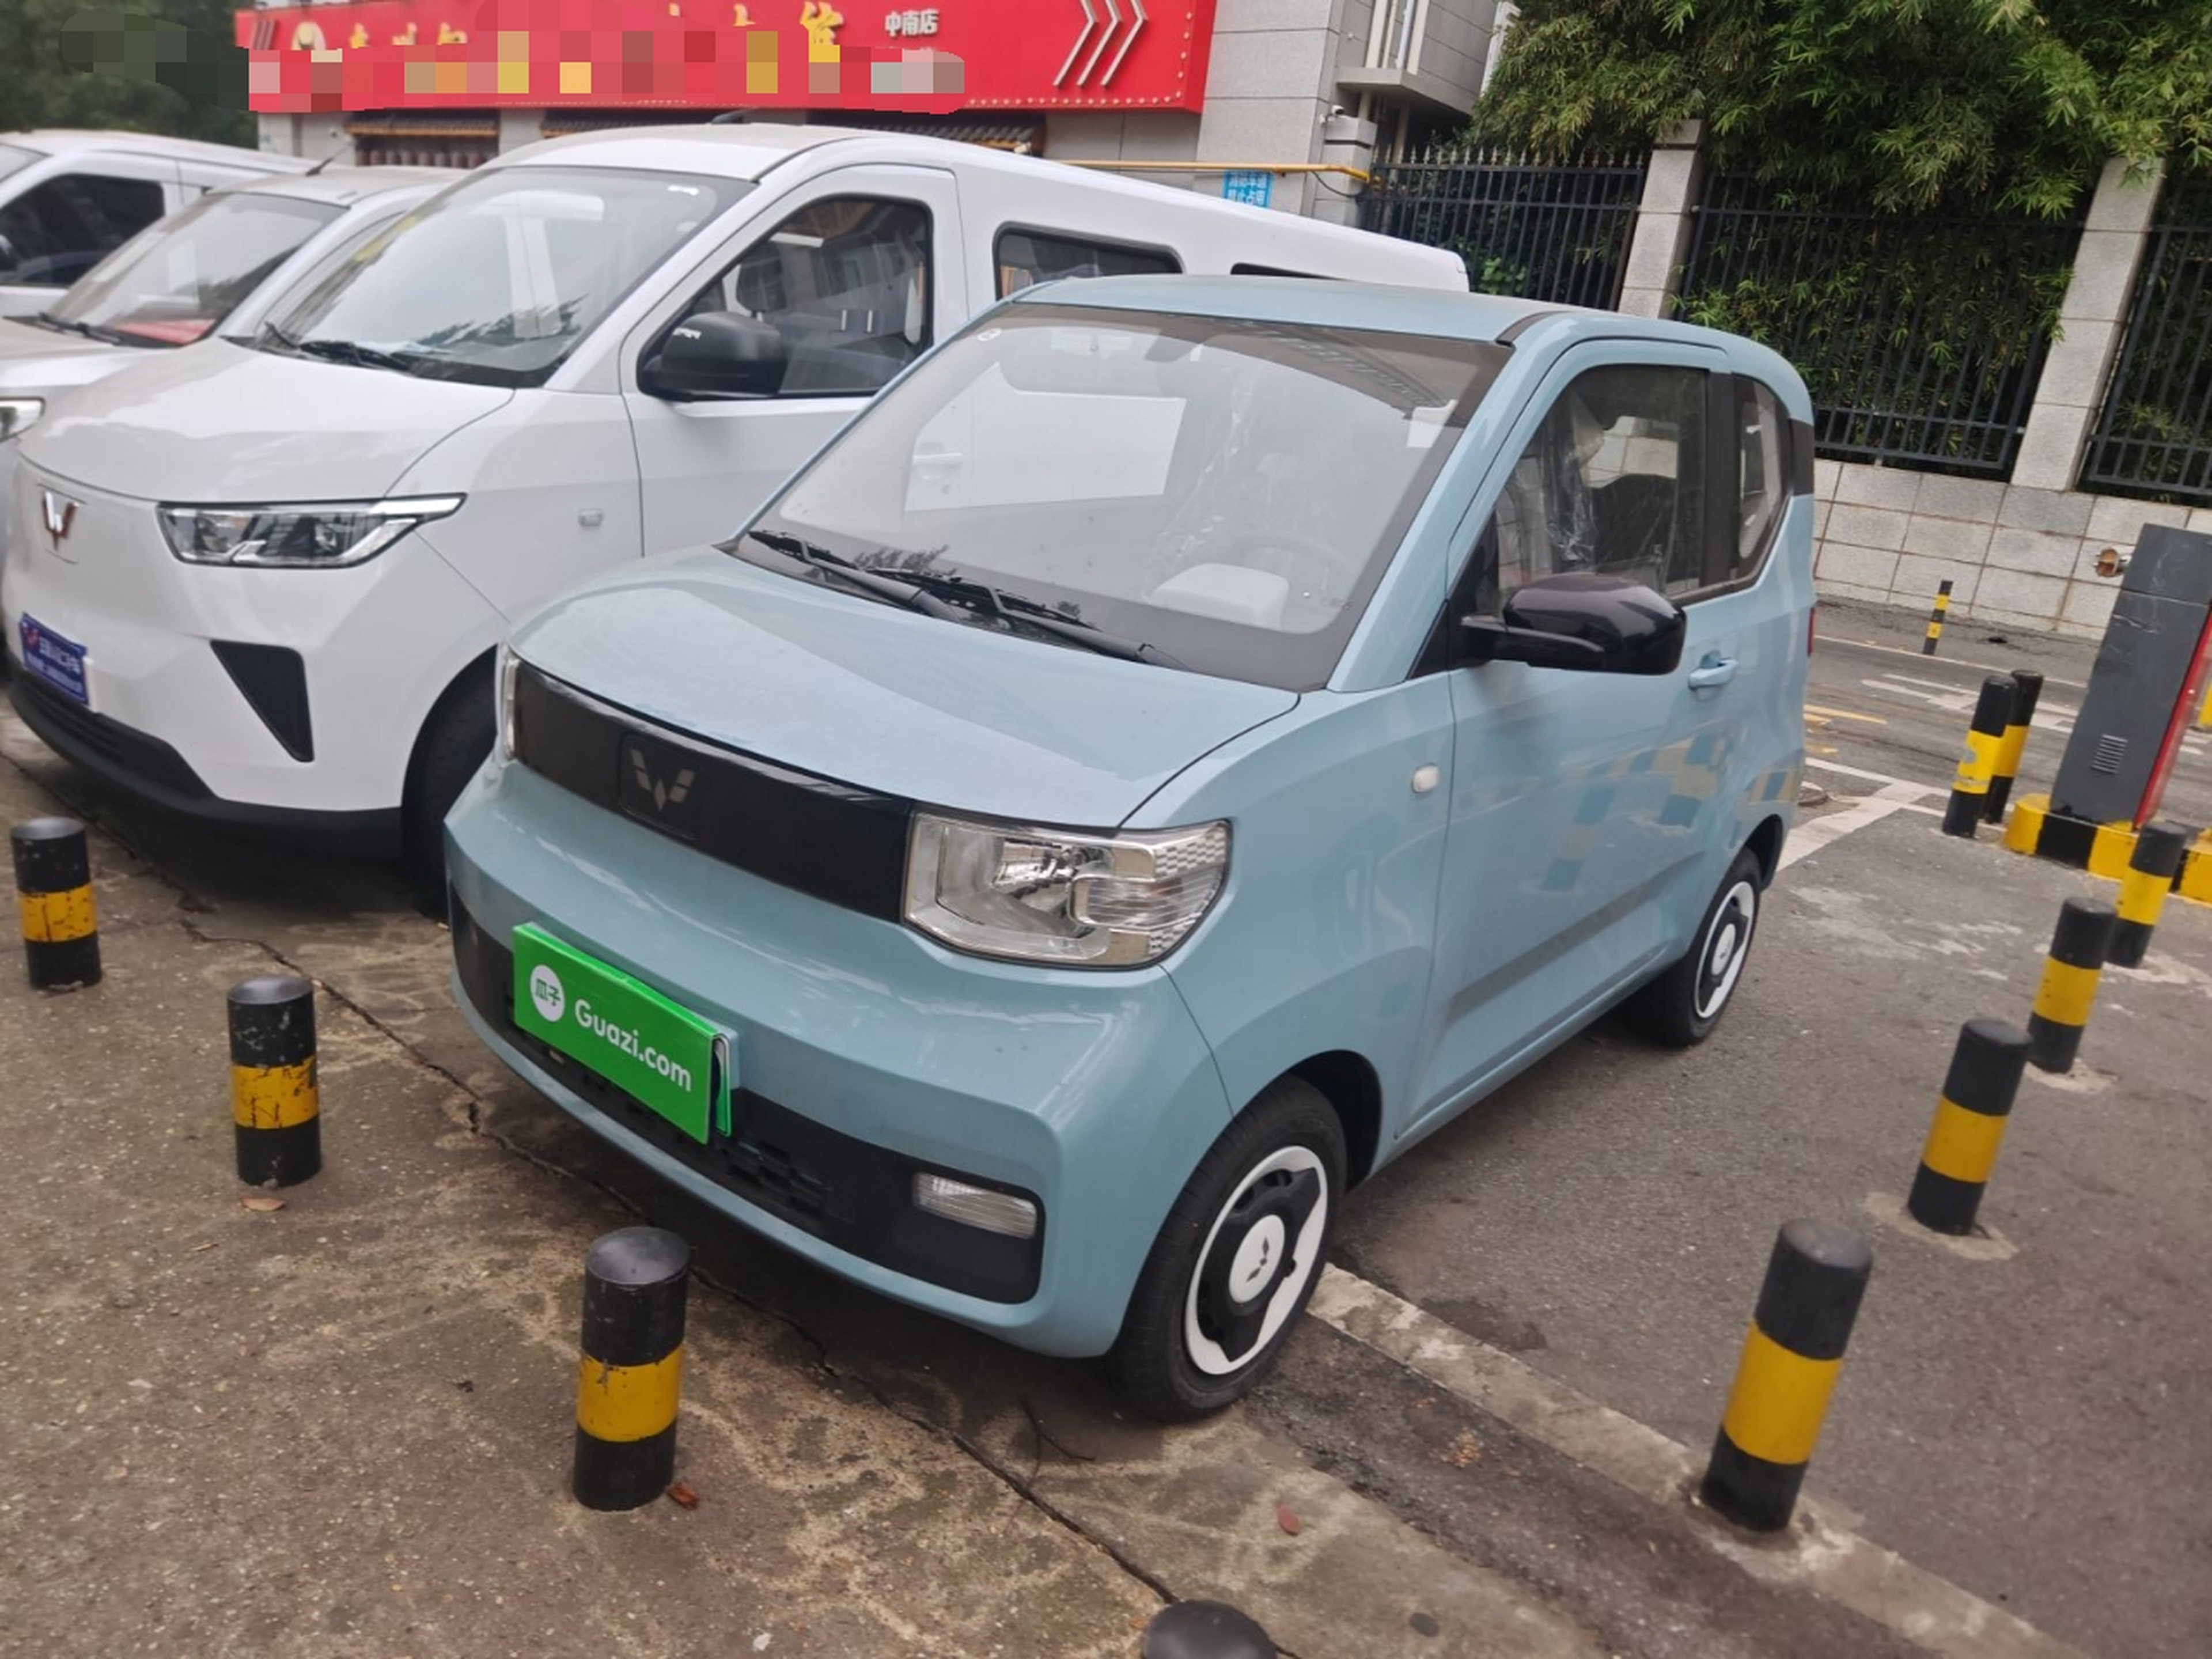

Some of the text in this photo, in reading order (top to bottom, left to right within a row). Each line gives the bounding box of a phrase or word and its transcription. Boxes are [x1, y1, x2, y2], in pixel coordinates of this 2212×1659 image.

[884, 9, 939, 37] 中南店
[535, 978, 561, 1007] 瓜子
[574, 998, 692, 1093] Guazi.com
